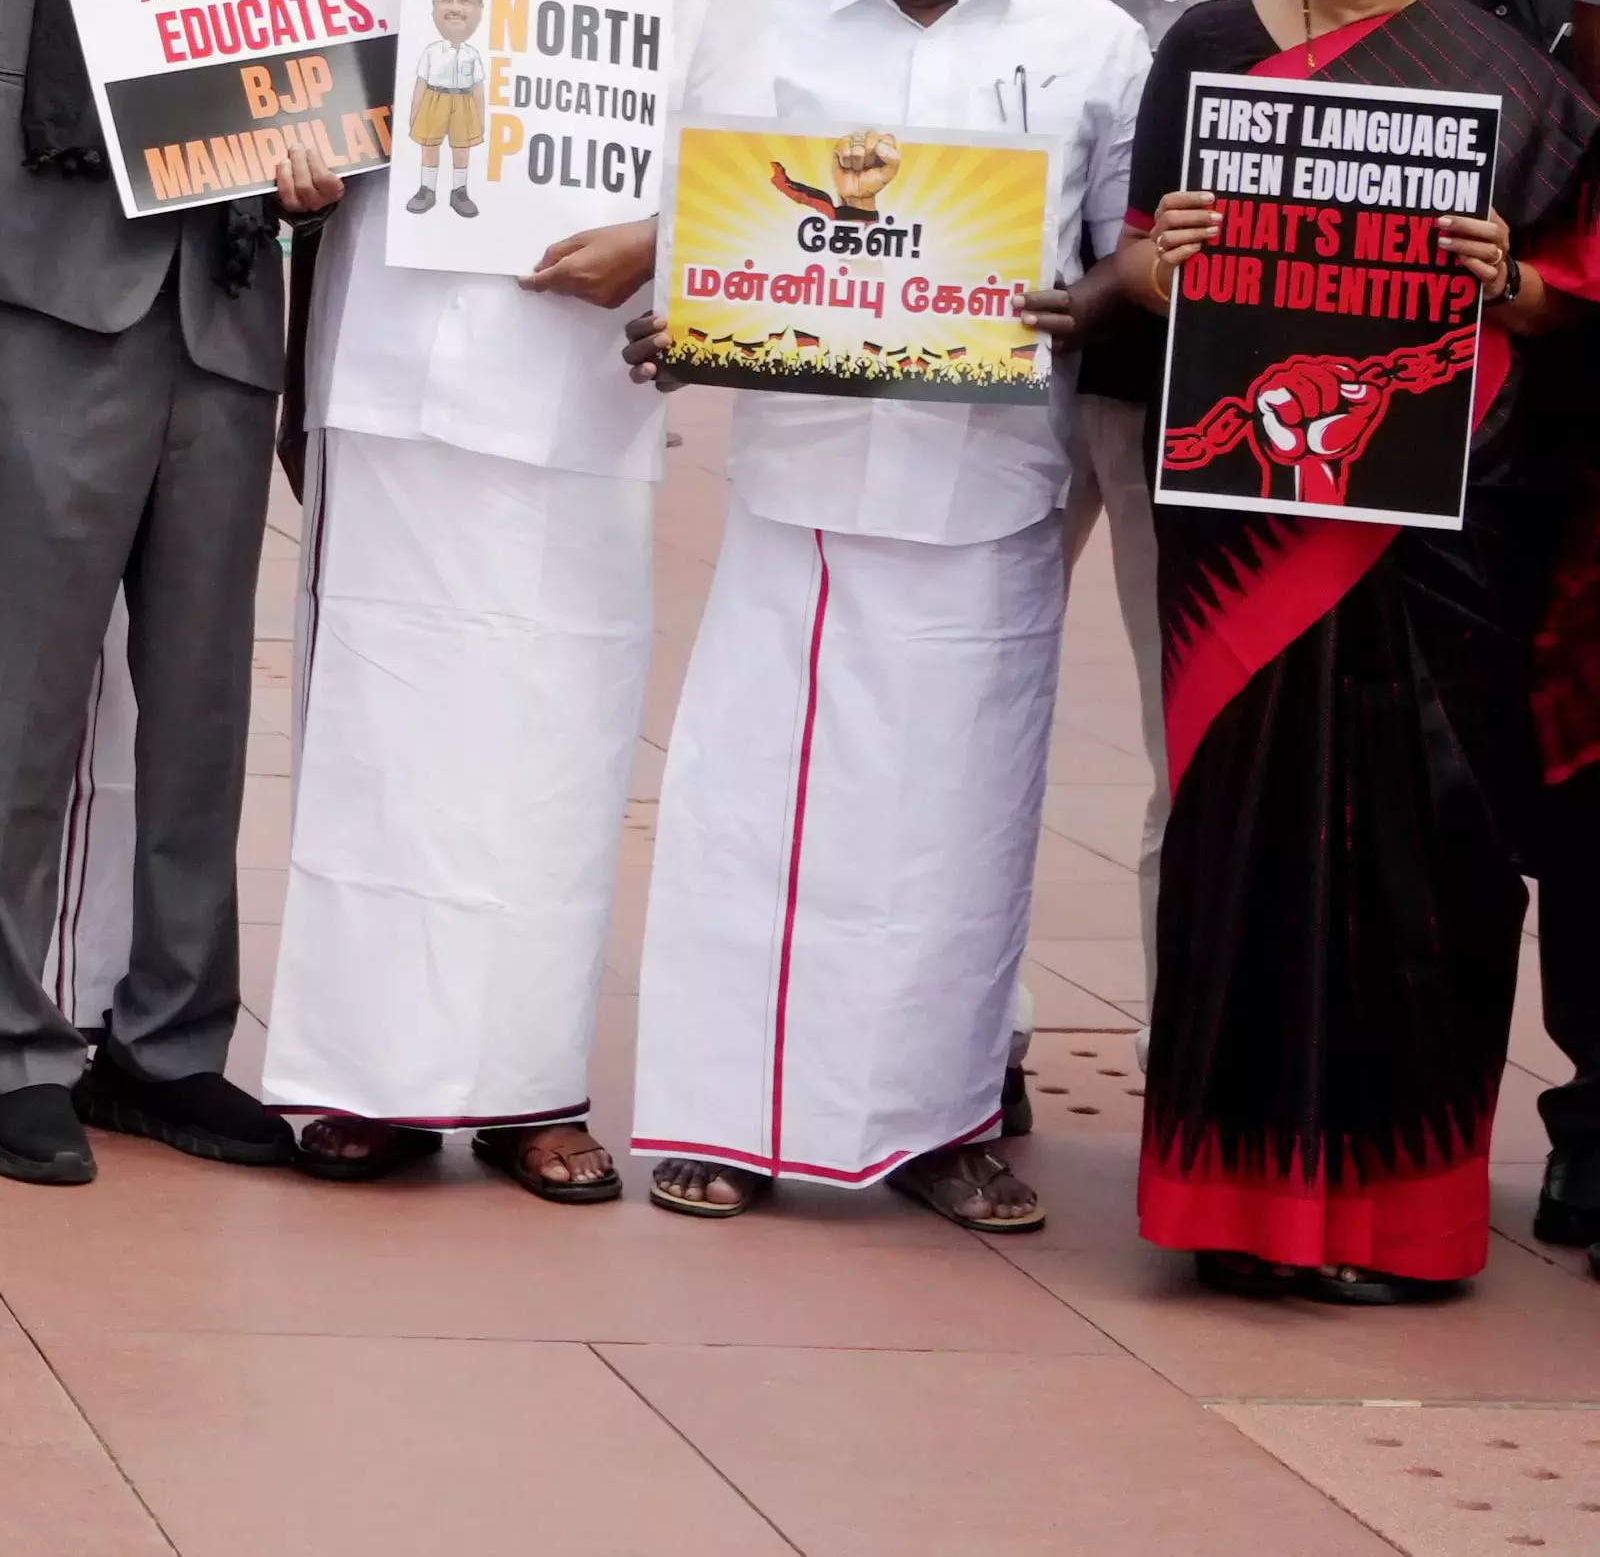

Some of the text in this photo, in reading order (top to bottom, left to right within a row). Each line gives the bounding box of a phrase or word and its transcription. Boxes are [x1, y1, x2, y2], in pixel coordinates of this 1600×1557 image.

[240, 55, 334, 120] BJP
[488, 56, 656, 127] EDUCATION
[486, 113, 653, 200] POLICY
[1199, 97, 1487, 167] FIRST LANGUAGE,
[1199, 149, 1480, 213] THEN EDUCATION
[798, 215, 922, 259] கேள்!
[686, 259, 883, 318] மன்னிப்பு
[1182, 251, 1479, 325] OUR IDENTITY?
